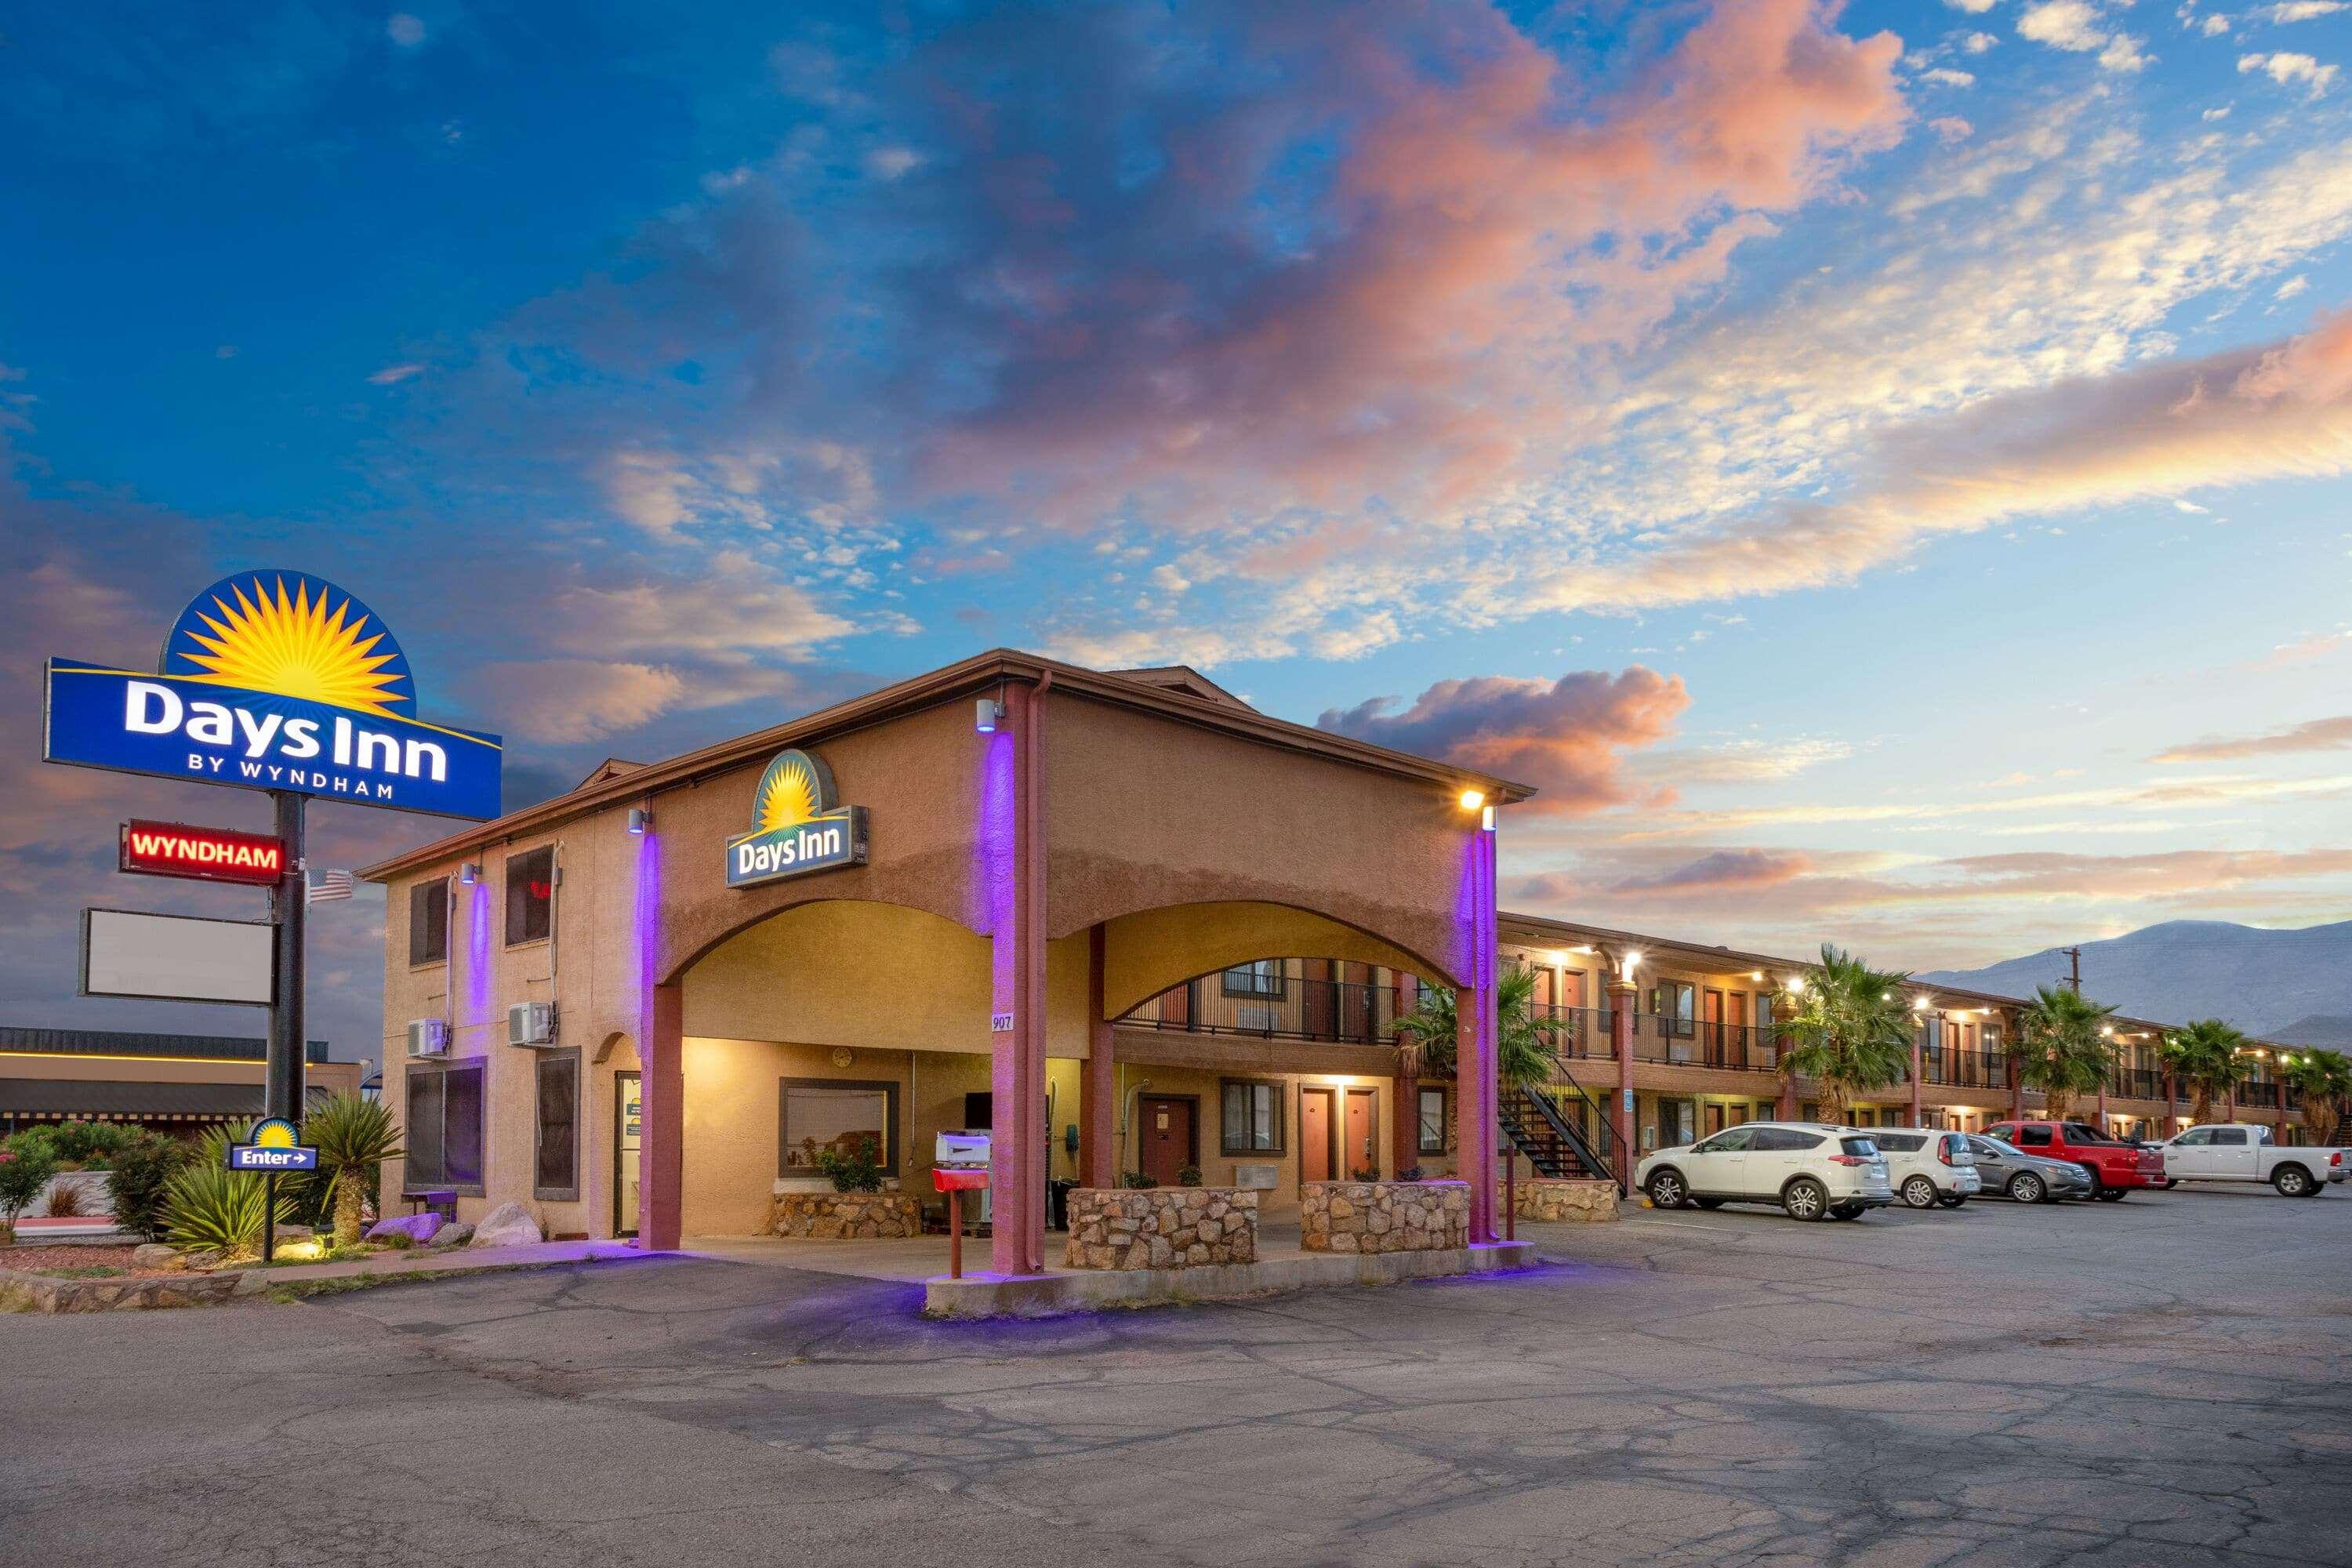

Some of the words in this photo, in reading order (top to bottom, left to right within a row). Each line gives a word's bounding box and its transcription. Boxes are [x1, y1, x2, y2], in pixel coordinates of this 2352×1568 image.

[125, 680, 321, 758] Days
[334, 717, 447, 782] Inn
[188, 753, 223, 772] BY
[240, 761, 392, 799] WYNDHAM
[132, 833, 278, 869] WYNDHAM
[739, 839, 796, 874] Days
[799, 828, 840, 861] Inn
[993, 1016, 1011, 1029] 907
[241, 1150, 292, 1164] Enter
